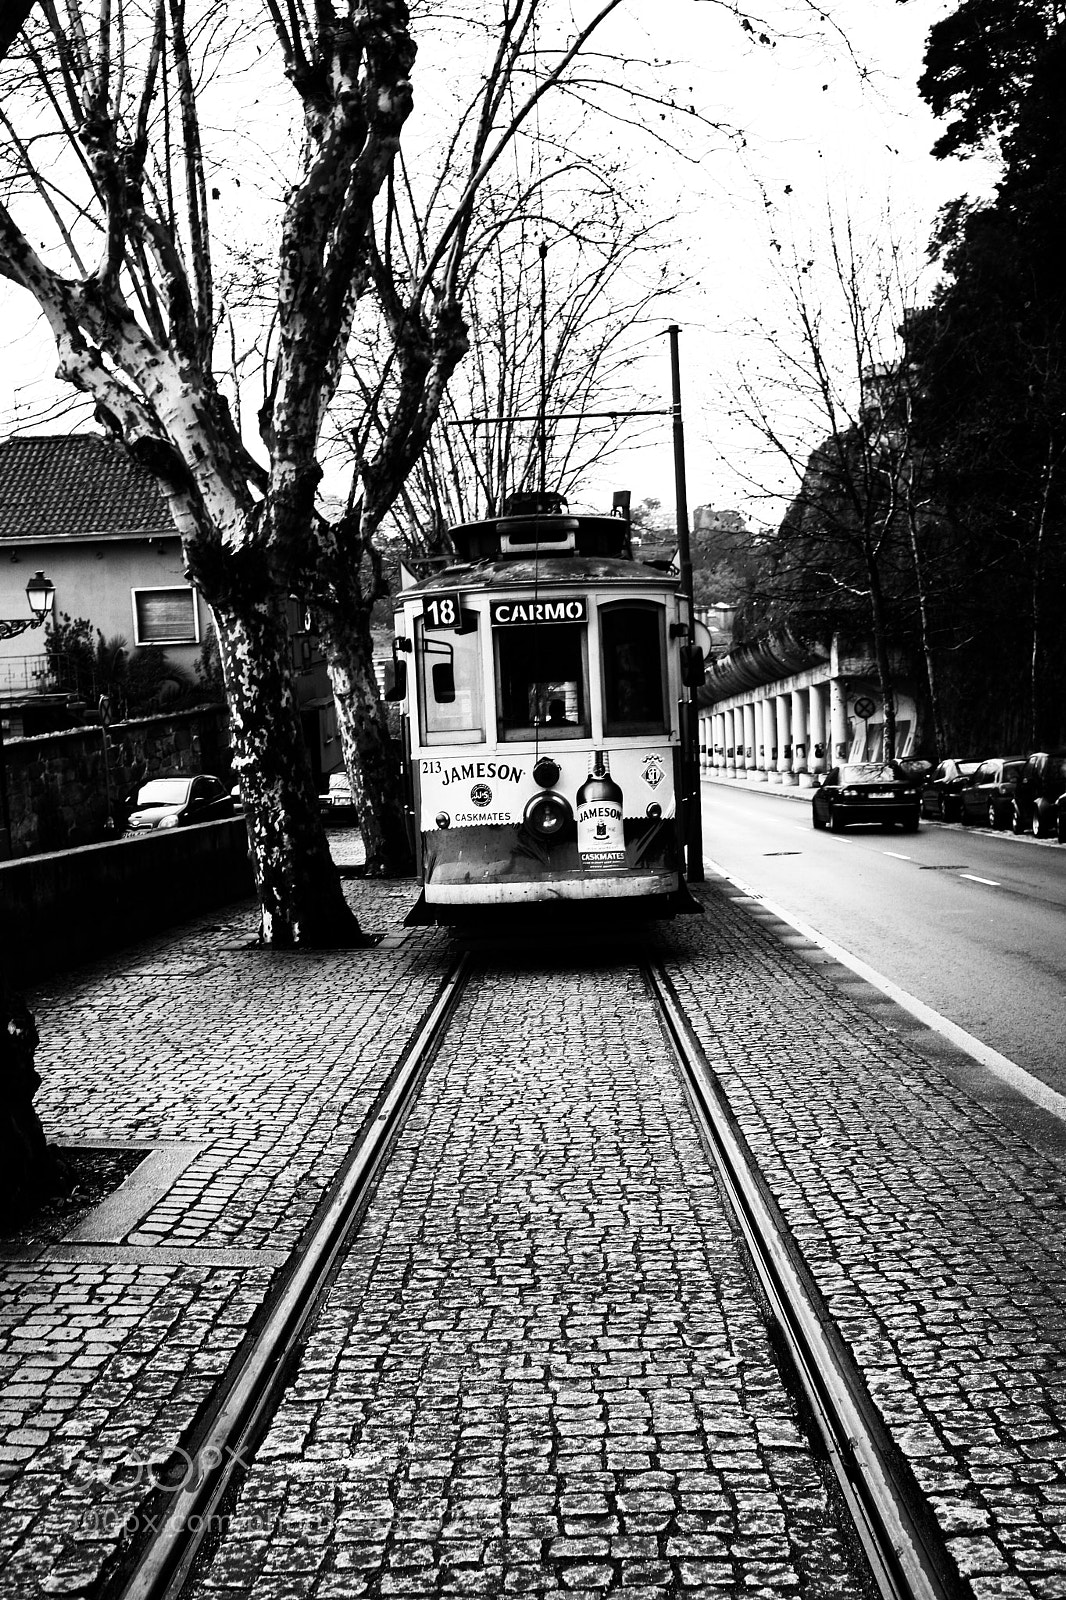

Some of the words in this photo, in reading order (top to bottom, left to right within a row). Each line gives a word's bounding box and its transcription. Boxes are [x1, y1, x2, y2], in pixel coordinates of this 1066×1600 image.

[427, 599, 456, 626] 18
[495, 602, 584, 622] CARMO
[422, 761, 442, 774] 213
[442, 763, 523, 786] JAMESON
[455, 812, 511, 822] CASKMATES
[579, 807, 622, 823] JAMESON
[581, 852, 625, 862] CASKMATES
